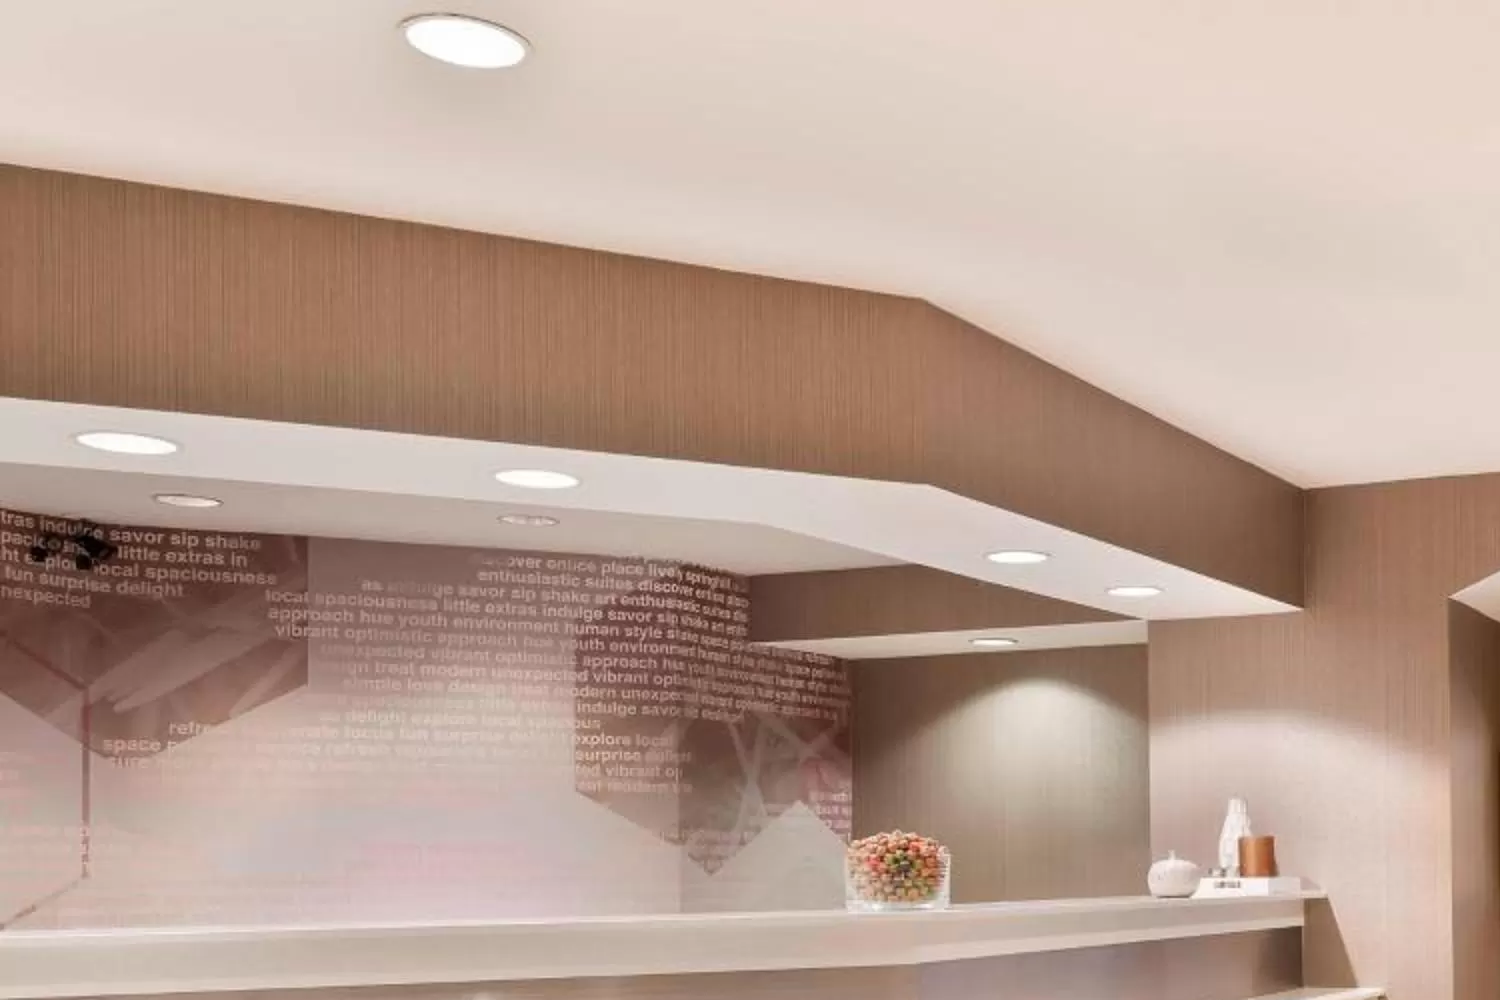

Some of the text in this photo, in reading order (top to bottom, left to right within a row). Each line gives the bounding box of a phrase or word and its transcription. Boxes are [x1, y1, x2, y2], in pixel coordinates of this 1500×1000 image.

[109, 529, 166, 545] savor
[170, 531, 199, 548] sip
[205, 535, 261, 551] shake
[117, 545, 160, 562] little
[164, 551, 225, 566] extras
[145, 566, 277, 586] spaciousness
[476, 570, 582, 588] enthusiastic
[601, 561, 644, 577] place
[4, 564, 185, 601] fun surprise delight
[0, 585, 91, 608] nexpected
[265, 589, 309, 603] local
[314, 592, 438, 611] spaciousness
[443, 596, 481, 613] little
[485, 602, 537, 614] extras
[541, 605, 603, 622] indulge
[608, 609, 653, 621] savor
[267, 608, 354, 624] approach
[360, 609, 395, 625] hue
[398, 613, 447, 630] youth
[453, 617, 560, 634] environment
[563, 623, 620, 637] human
[624, 627, 663, 644] style
[274, 623, 339, 639] vibrant
[344, 628, 432, 644] optimistic
[559, 638, 605, 653] youth
[583, 655, 657, 671] approach
[591, 670, 649, 685] vibrant
[576, 700, 638, 718] indulge
[103, 738, 161, 756] space
[575, 751, 641, 765] surprise
